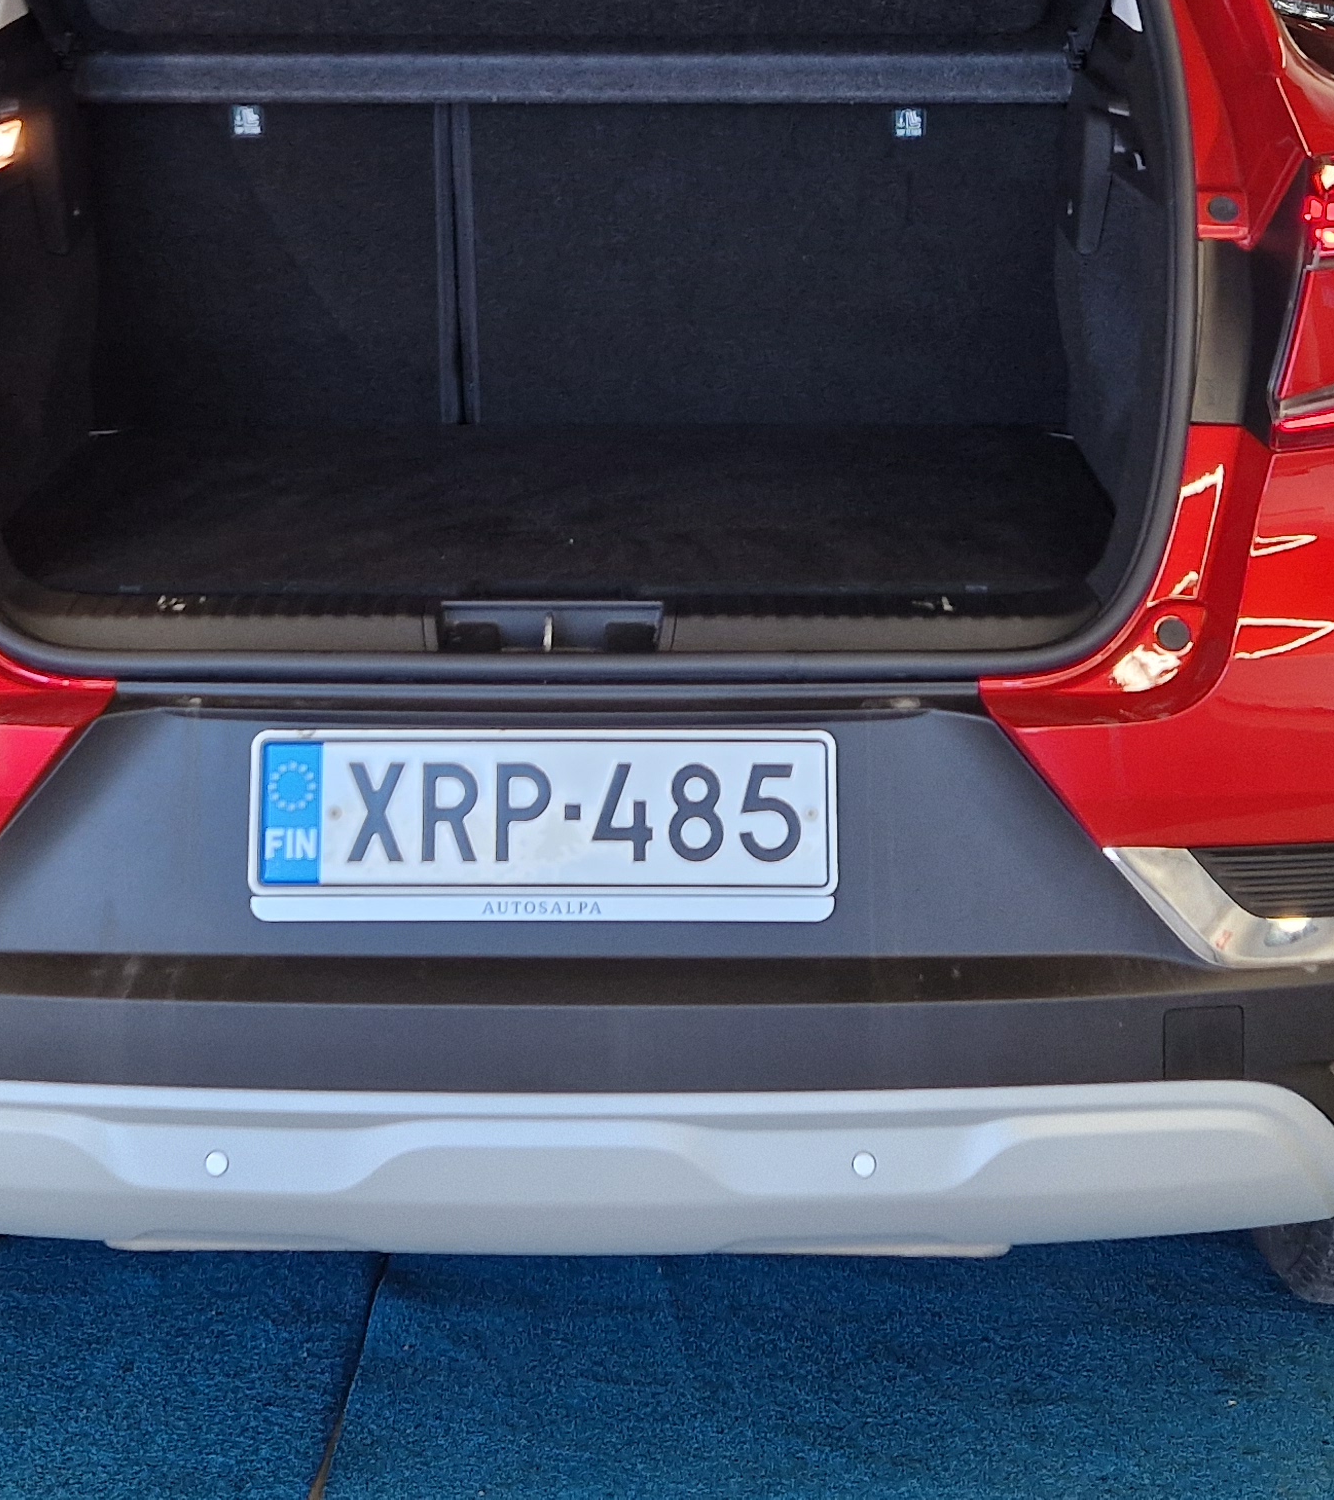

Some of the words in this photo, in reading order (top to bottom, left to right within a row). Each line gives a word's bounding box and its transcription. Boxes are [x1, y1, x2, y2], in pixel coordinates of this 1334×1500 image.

[346, 761, 803, 863] XRP-485
[264, 826, 318, 861] FIN
[481, 899, 603, 916] AUTOSALPA
